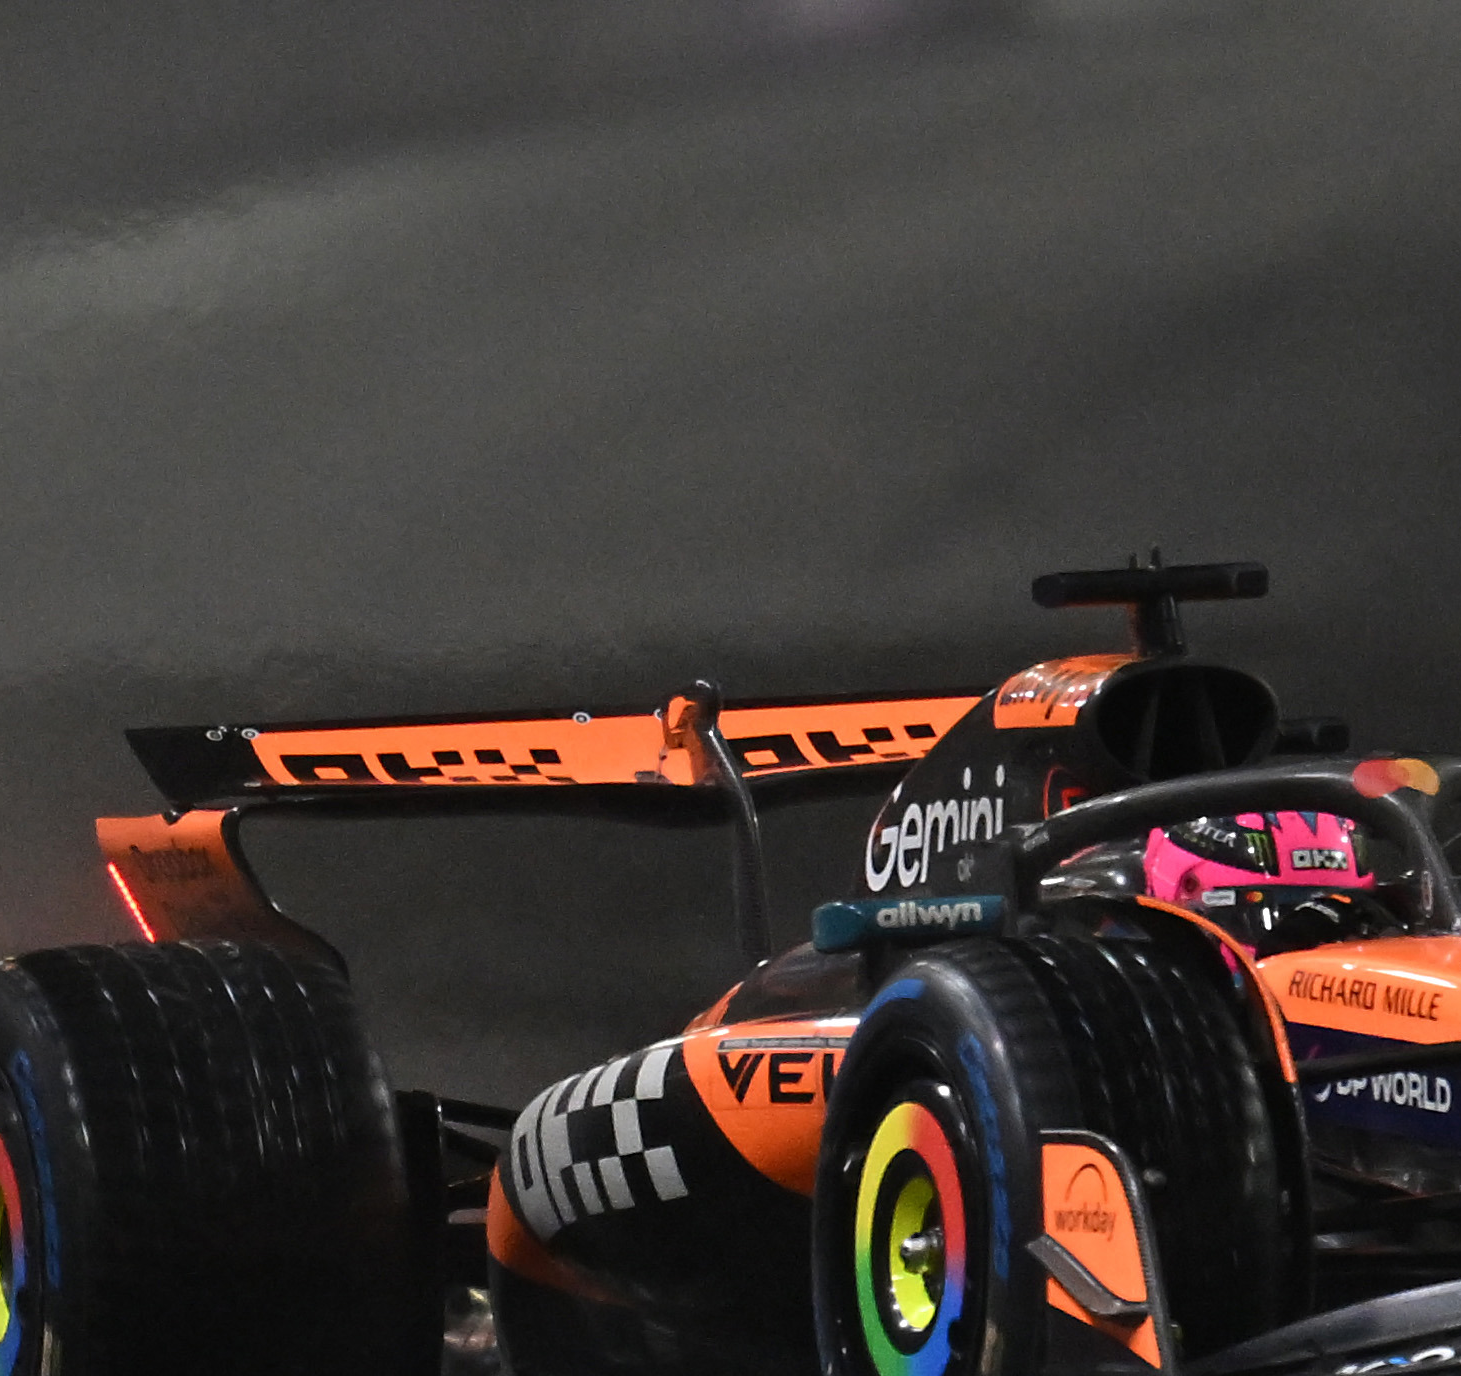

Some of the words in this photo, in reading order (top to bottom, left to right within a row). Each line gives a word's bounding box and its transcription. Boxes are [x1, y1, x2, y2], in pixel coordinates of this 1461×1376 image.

[865, 764, 1005, 893] Gemini
[876, 902, 983, 930] allwyn
[1289, 970, 1377, 1010] RICHARD
[1384, 985, 1443, 1021] MILLE
[1372, 1072, 1452, 1114] WORLD
[1054, 1201, 1117, 1243] workday
